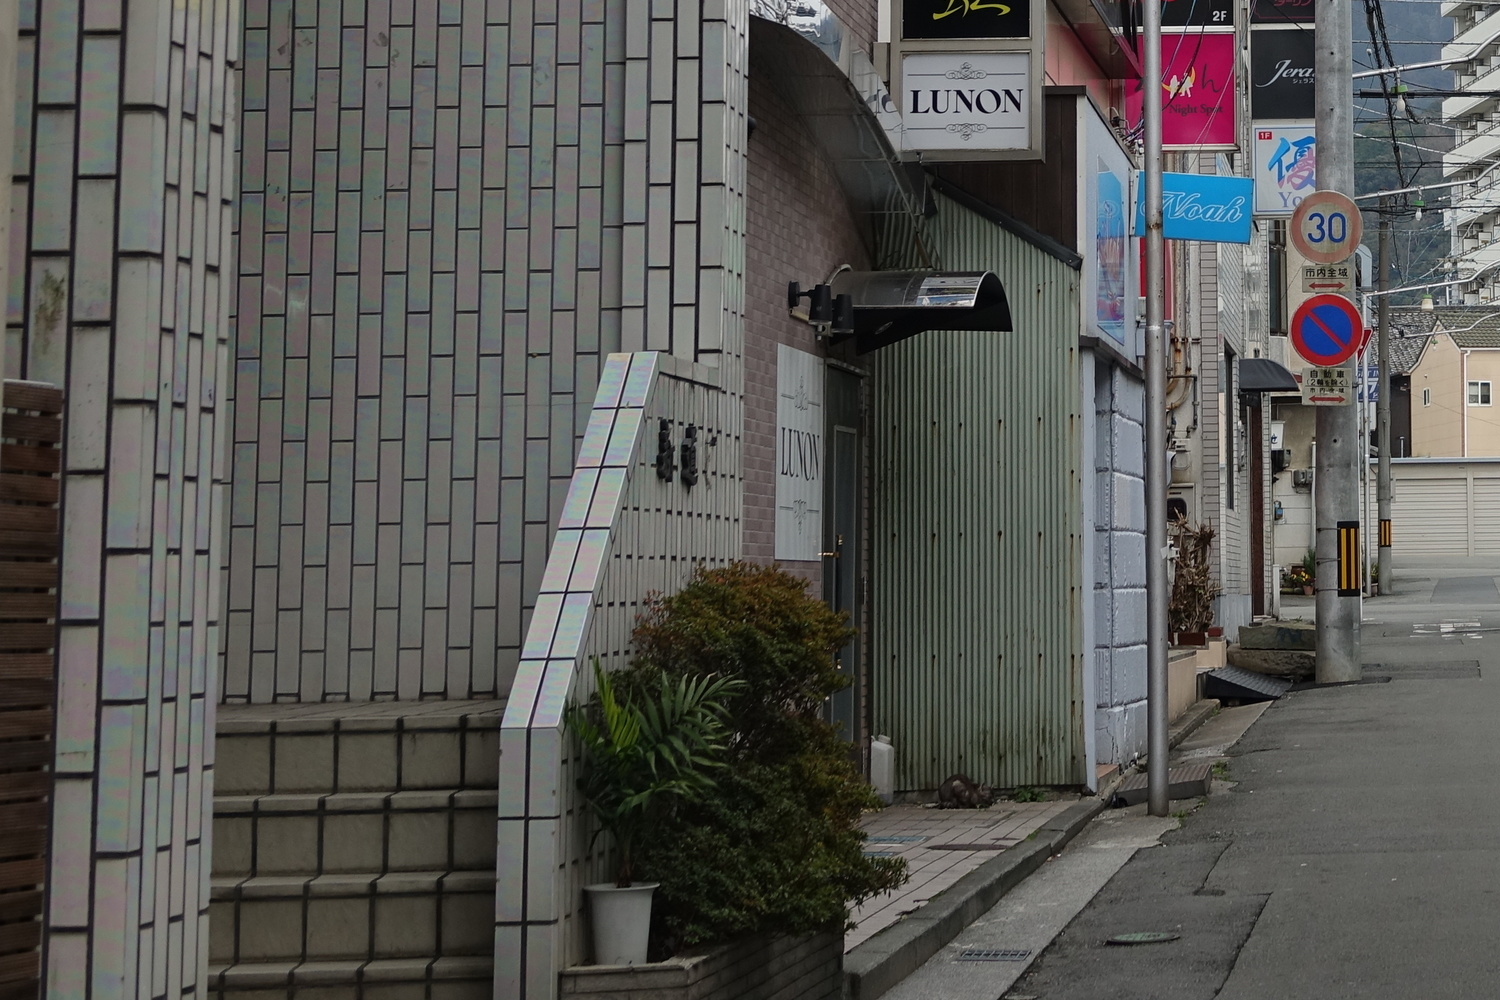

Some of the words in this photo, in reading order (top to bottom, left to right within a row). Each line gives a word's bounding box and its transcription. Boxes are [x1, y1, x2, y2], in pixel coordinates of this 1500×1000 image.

[1212, 11, 1228, 22] 2F
[1255, 59, 1315, 88] Jera
[910, 89, 1024, 114] LUNON
[1169, 104, 1198, 115] Night
[1200, 104, 1224, 115] Spot
[1307, 212, 1347, 243] 30
[1305, 268, 1348, 278] 市内全域
[1310, 370, 1345, 378] 自動車
[780, 426, 821, 482] LUNON
